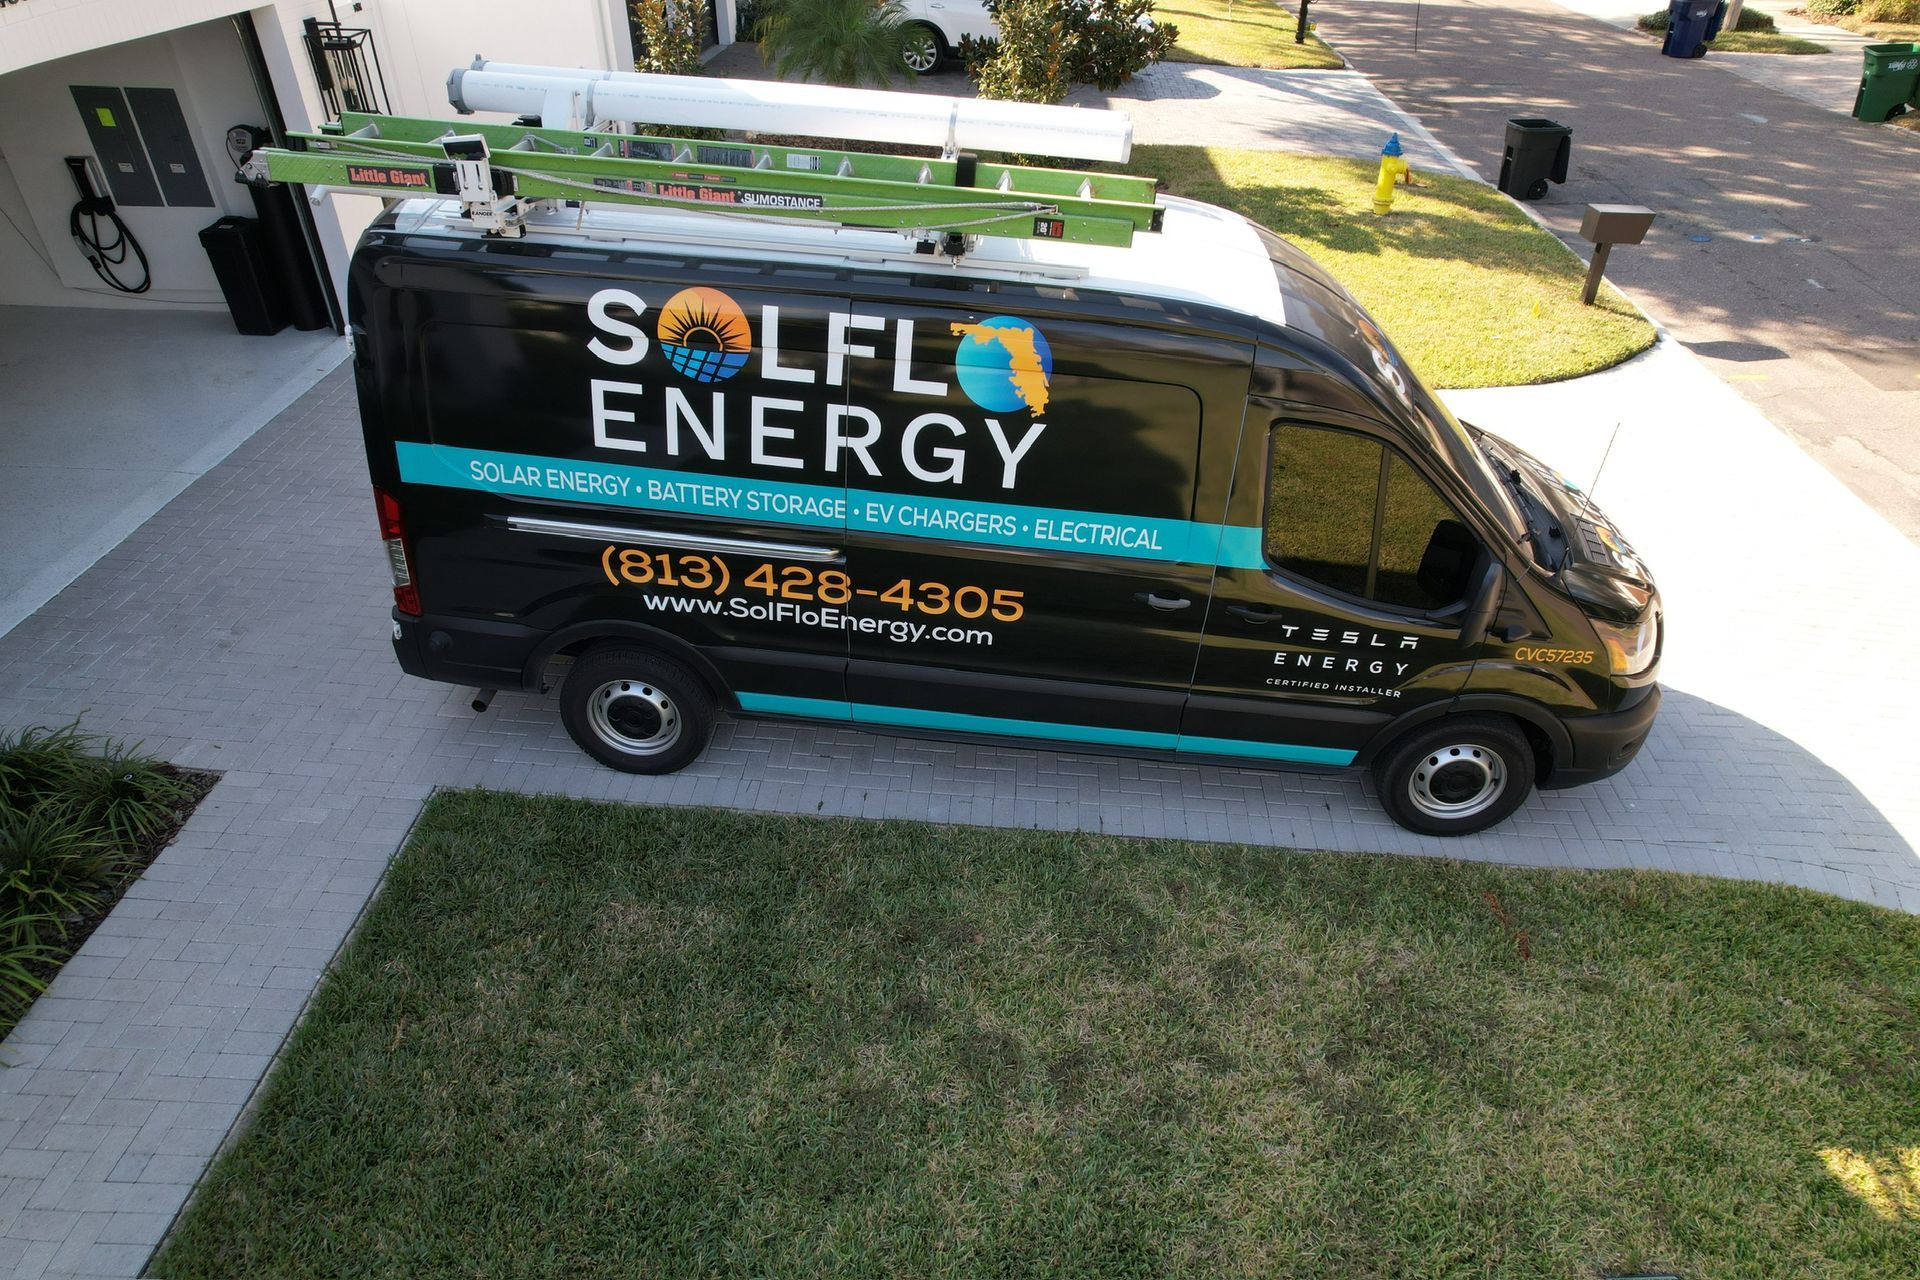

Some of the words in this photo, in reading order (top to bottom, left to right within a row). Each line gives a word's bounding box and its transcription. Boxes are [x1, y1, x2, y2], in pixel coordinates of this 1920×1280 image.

[350, 167, 386, 183] Little
[389, 170, 426, 186] Giant
[659, 184, 695, 200] Little
[699, 187, 736, 203] Giant
[743, 192, 821, 209] SUMOSTANCE
[590, 378, 1047, 489] ENERGY
[469, 460, 541, 487] SOLAR
[546, 468, 631, 497] ENERGY
[648, 480, 743, 509] BATTERY
[747, 489, 846, 519] STORAGE
[866, 502, 894, 524] EV
[898, 506, 1017, 536] CHARGERS
[1034, 519, 1163, 550] ELECTRICAL
[601, 545, 731, 596] (813)
[743, 563, 1025, 622] 428-4305
[643, 593, 993, 646] www.SolFloEnergy.com
[1281, 624, 1420, 650] TESLA
[1273, 652, 1409, 676] ENERGY
[1514, 647, 1594, 664] CVC57235
[1265, 677, 1330, 691] CERTIFIED
[1334, 683, 1402, 699] INSTALLER
